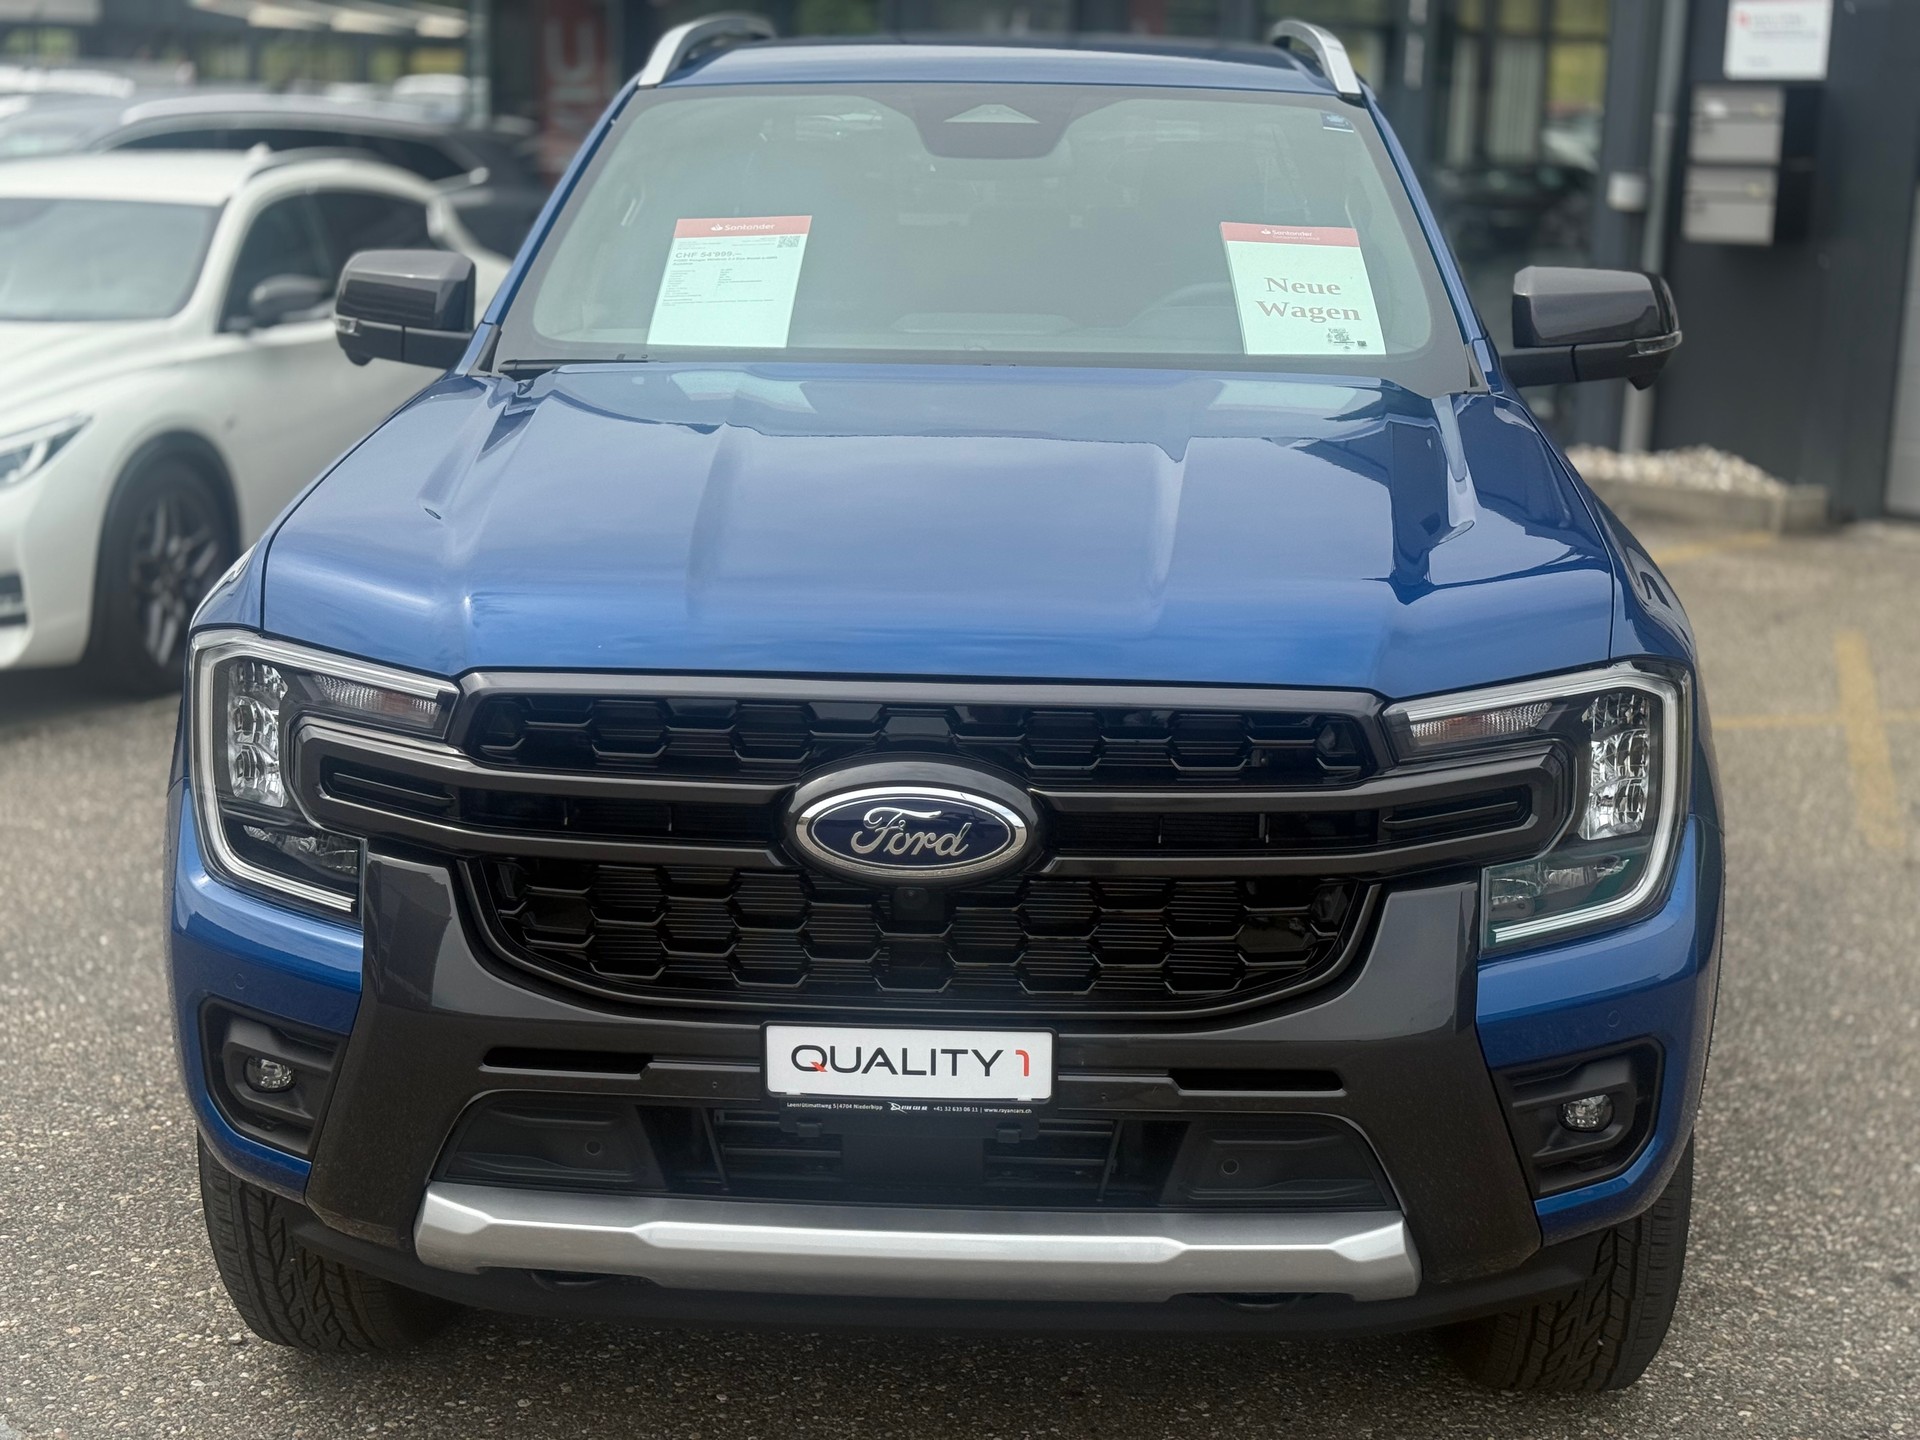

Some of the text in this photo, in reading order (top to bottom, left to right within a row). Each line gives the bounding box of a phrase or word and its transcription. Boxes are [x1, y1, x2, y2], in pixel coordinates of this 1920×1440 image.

[724, 223, 776, 231] Santander
[675, 251, 698, 259] CHF
[1264, 277, 1342, 296] Neue
[1256, 300, 1362, 324] Wagen
[850, 806, 973, 857] Ford
[791, 1044, 1030, 1077] QUALITY 1
